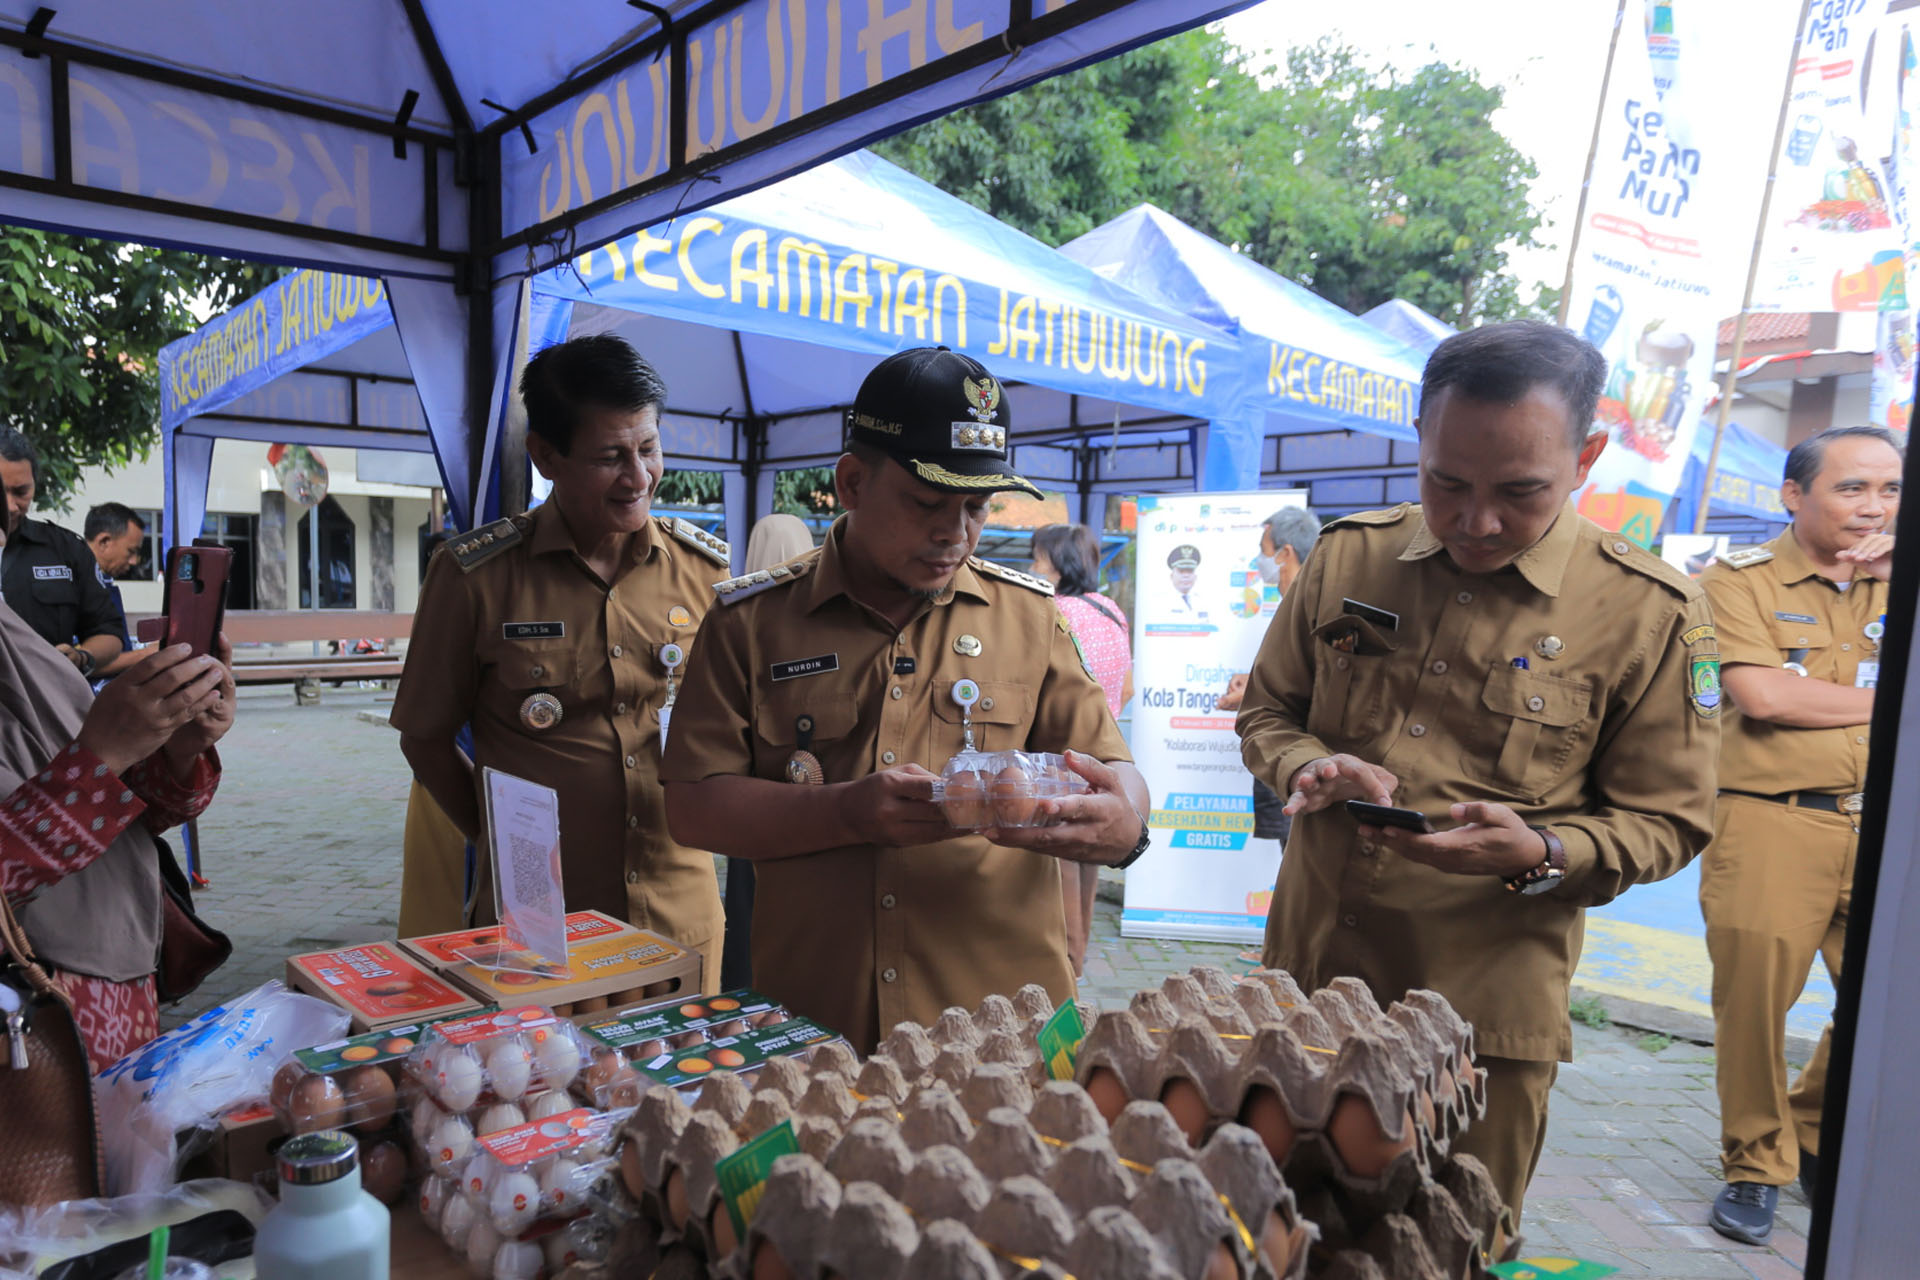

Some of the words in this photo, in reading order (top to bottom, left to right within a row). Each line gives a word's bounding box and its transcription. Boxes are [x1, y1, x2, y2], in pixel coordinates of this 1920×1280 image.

[171, 297, 269, 412] KECAMATAN
[276, 268, 388, 355] JATIUWU
[988, 289, 1207, 397] JATIUWUNG
[1267, 342, 1413, 427] KECAMATAN
[788, 660, 822, 674] NURDIN
[1142, 687, 1174, 708] Kota
[1173, 795, 1248, 812] PELAYANAN
[1151, 814, 1221, 828] KESEHATAN
[1186, 832, 1232, 848] GRATIS
